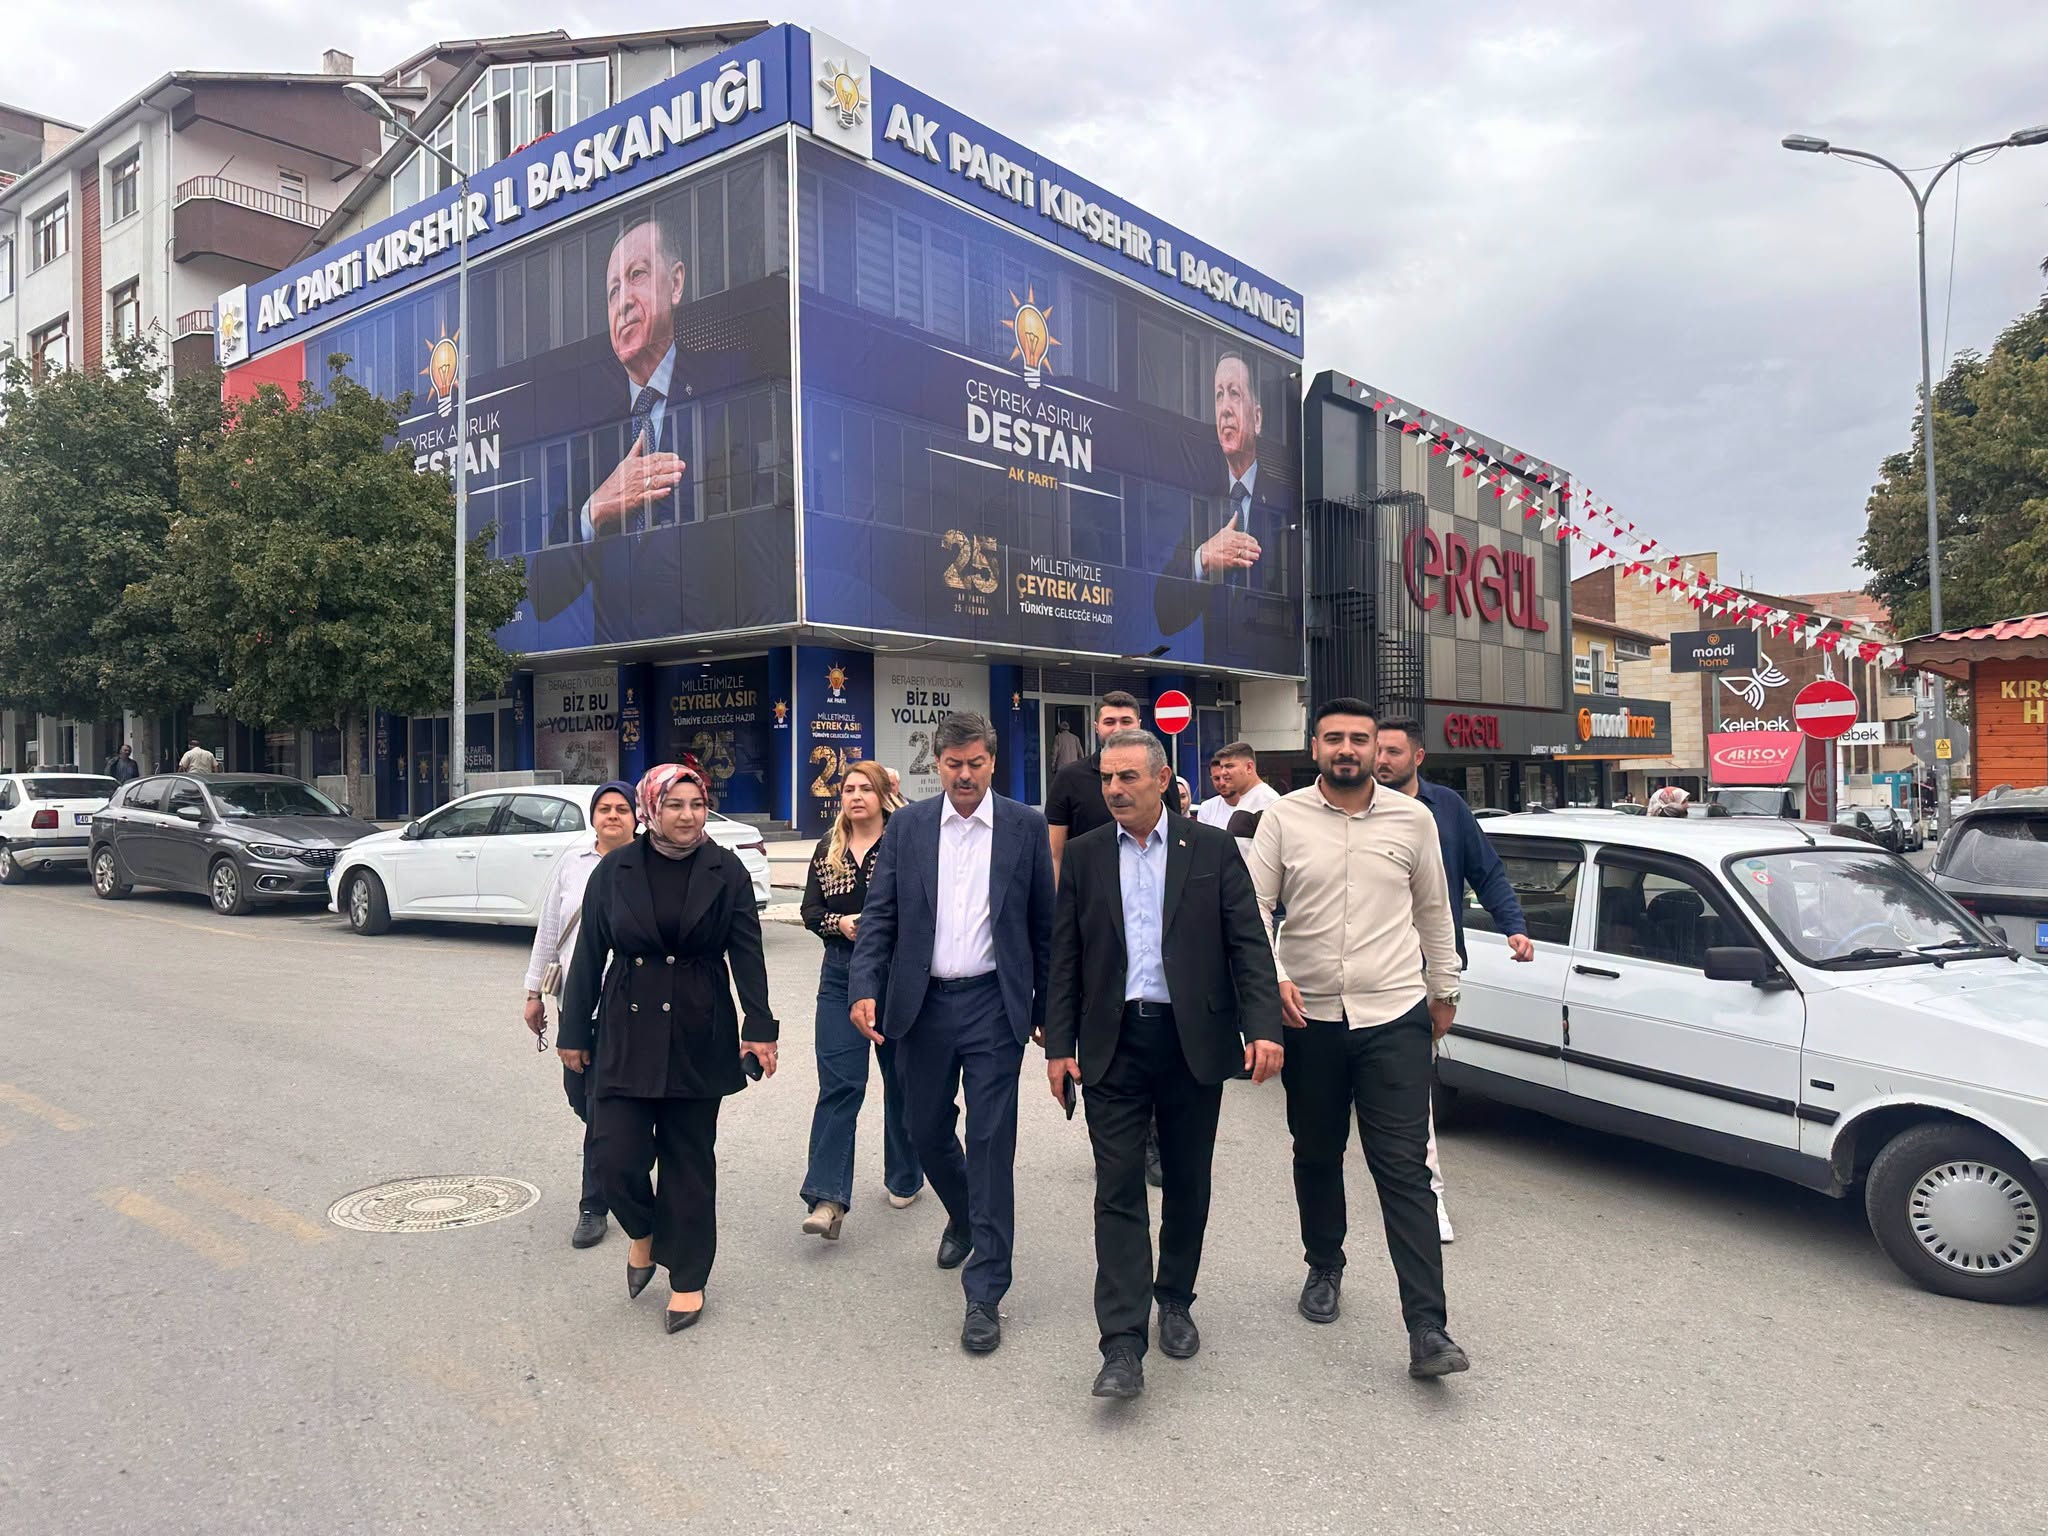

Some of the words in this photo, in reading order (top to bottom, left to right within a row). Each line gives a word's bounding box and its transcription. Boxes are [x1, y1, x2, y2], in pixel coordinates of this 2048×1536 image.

[256, 283, 294, 333] AK
[296, 250, 362, 314] PARTİ
[366, 191, 490, 283] KIRŞEHİR
[494, 177, 522, 224] İL
[527, 59, 762, 209] BAŞKANLIĞI
[884, 104, 942, 164] AK
[948, 131, 1034, 208] PARTİ
[1040, 179, 1153, 266] KIRŞEHİR
[1156, 239, 1177, 277] İL
[1180, 251, 1301, 337] BAŞKANLIĞI
[965, 379, 1032, 418] ÇEYREK
[1035, 400, 1093, 436] ASIRLIK
[447, 410, 500, 443] AIRLIK
[967, 402, 1092, 473] DESTAN
[414, 433, 499, 480] ESTAN
[1008, 466, 1026, 484] AK
[1027, 471, 1058, 490] PARTİ
[941, 528, 1000, 594] 25
[1029, 554, 1102, 583] MİLLETİMİZLE
[1015, 572, 1077, 601] ÇEYREK
[1080, 582, 1115, 607] ASIR
[1019, 600, 1054, 617] TÜRKİYE
[1054, 604, 1091, 622] GELECEĞE
[1092, 613, 1113, 625] HAZIR
[1692, 642, 1736, 658] mondi
[1699, 656, 1729, 668] home
[681, 675, 745, 693] MİLLETİMİZLE
[891, 674, 926, 687] BERABER
[563, 691, 585, 713] BİZ
[589, 693, 609, 711] BU
[671, 692, 721, 715] ÇEYREK
[724, 690, 758, 707] ASIR
[906, 687, 929, 706] BİZ
[932, 692, 951, 707] BU
[673, 714, 701, 727] TÜRKİYE
[701, 713, 735, 724] GELECEĞE
[735, 712, 756, 722] HAZIR
[810, 720, 843, 732] ÇEYREK
[843, 721, 862, 732] ASIR
[817, 712, 856, 722] MİLLETİMİZLE
[891, 708, 954, 725] YOLLAR
[1719, 716, 1790, 733] Kelebek
[1839, 727, 1879, 741] ebek
[464, 754, 493, 767] RŞEHİR
[1727, 748, 1789, 760] ARISOY
[80, 815, 89, 823] 40
